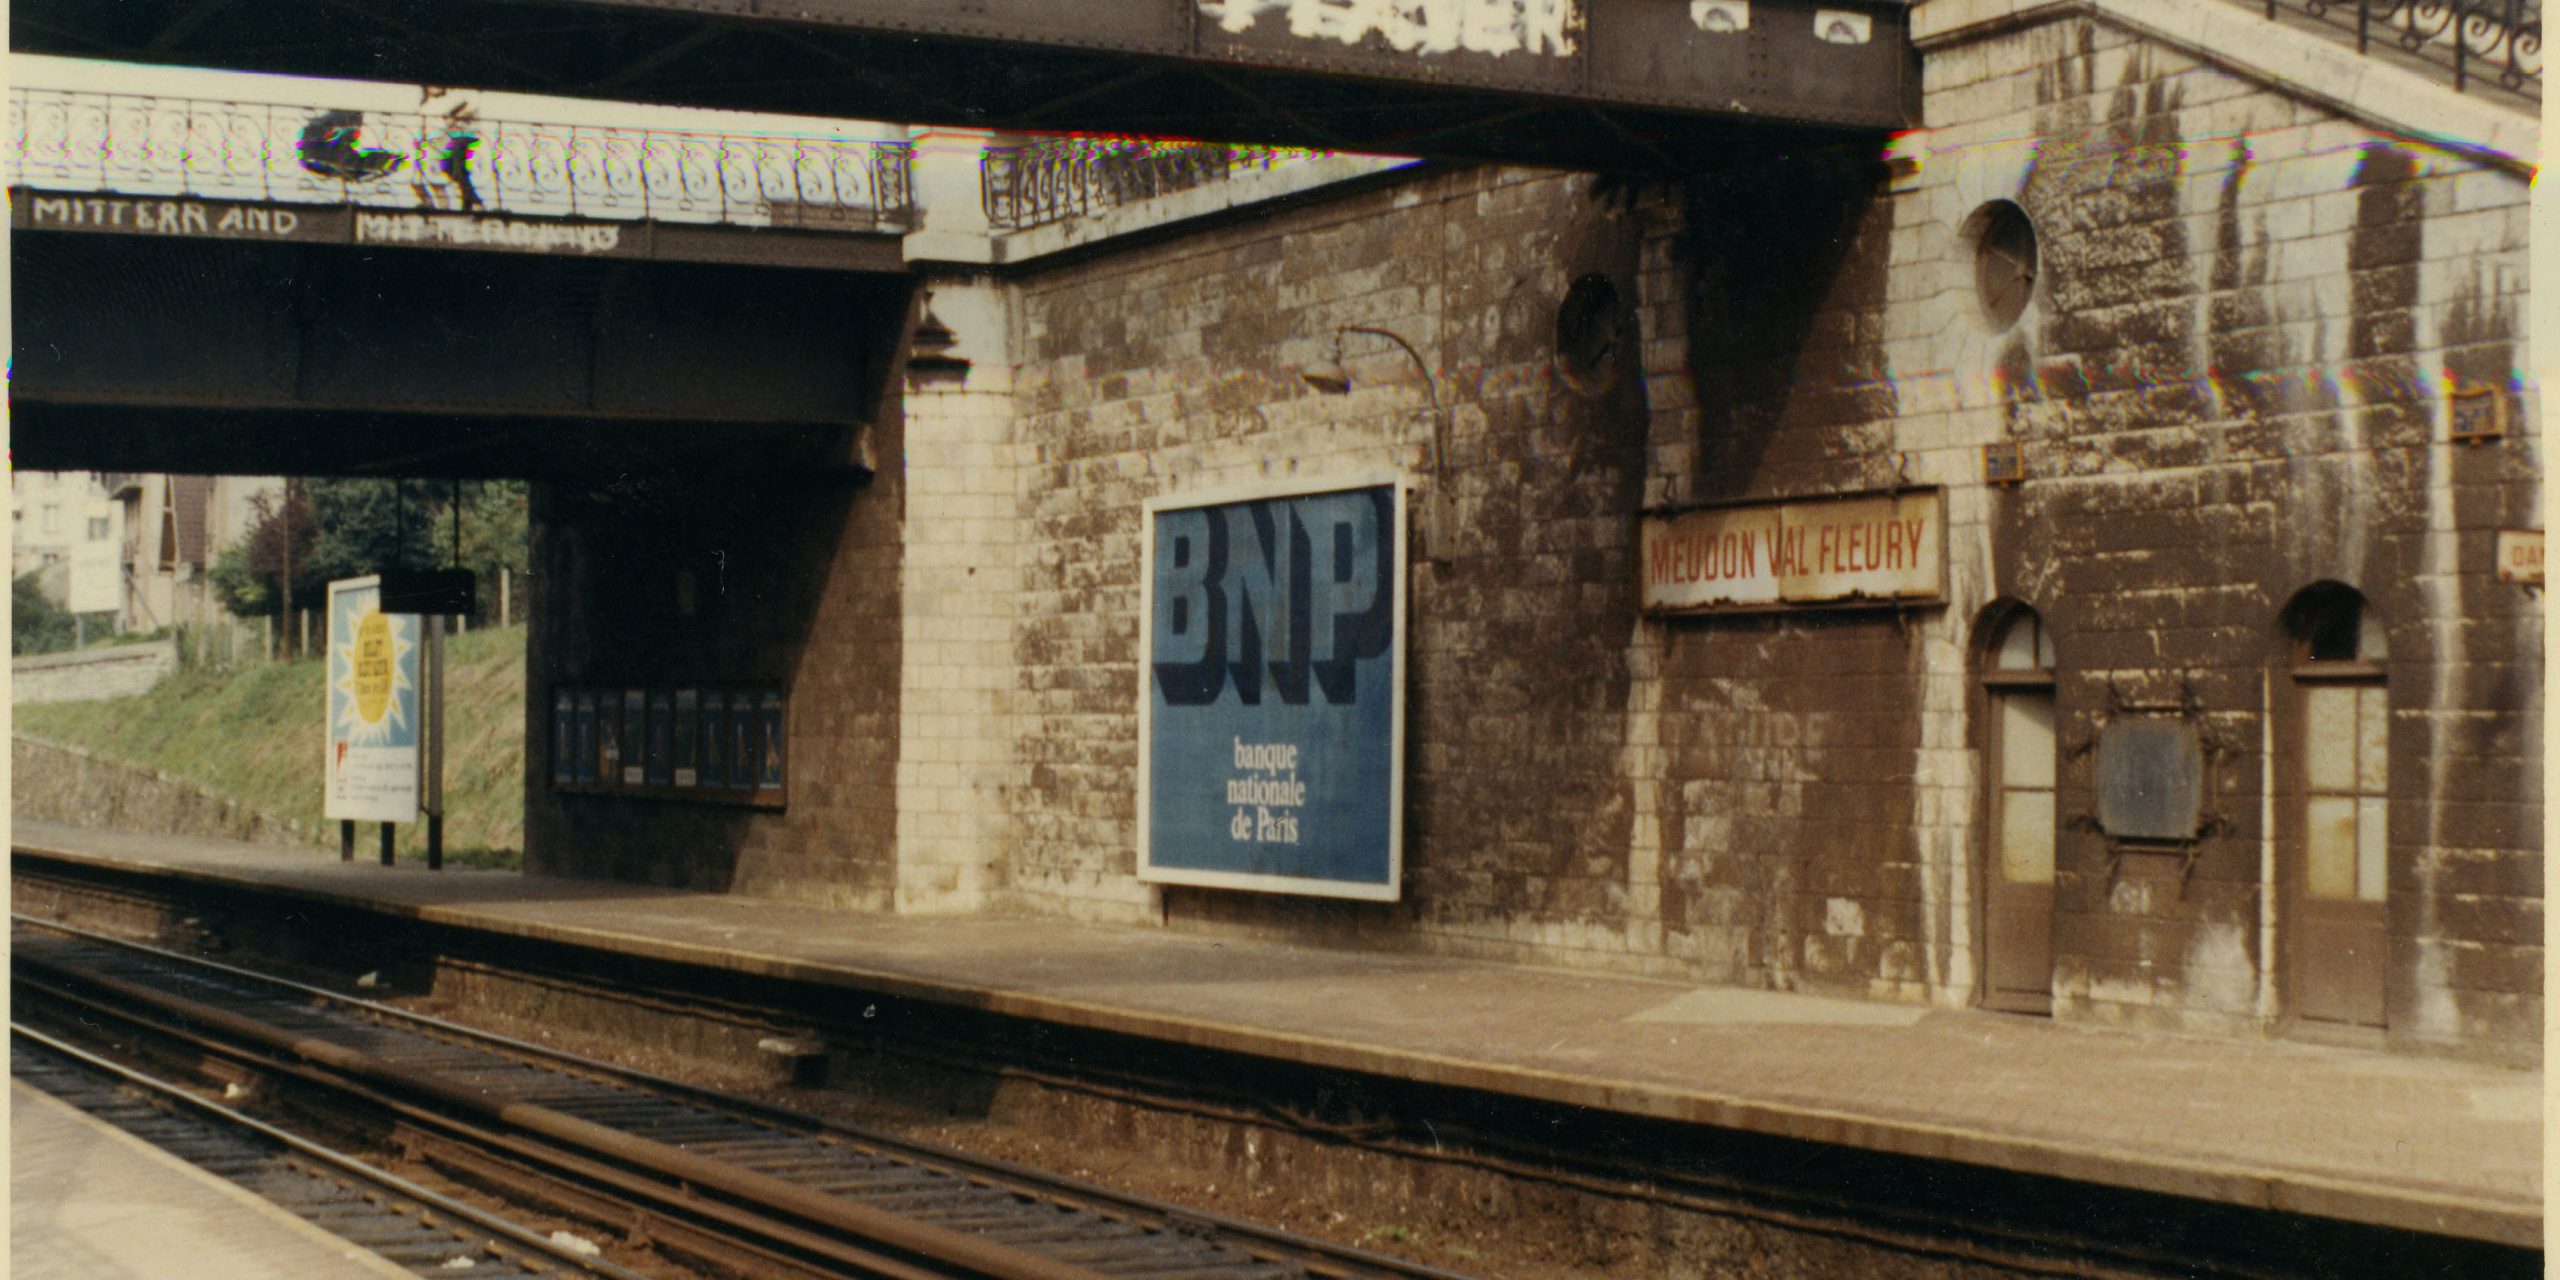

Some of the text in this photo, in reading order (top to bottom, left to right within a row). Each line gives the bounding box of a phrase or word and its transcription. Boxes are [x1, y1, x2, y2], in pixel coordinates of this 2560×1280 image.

[1651, 517, 1925, 585] MEUDON VAL FLEURY
[1153, 489, 1393, 705] BNP
[1233, 735, 1298, 777] banque
[1226, 772, 1306, 807] nationale
[1231, 805, 1299, 843] de Paris
